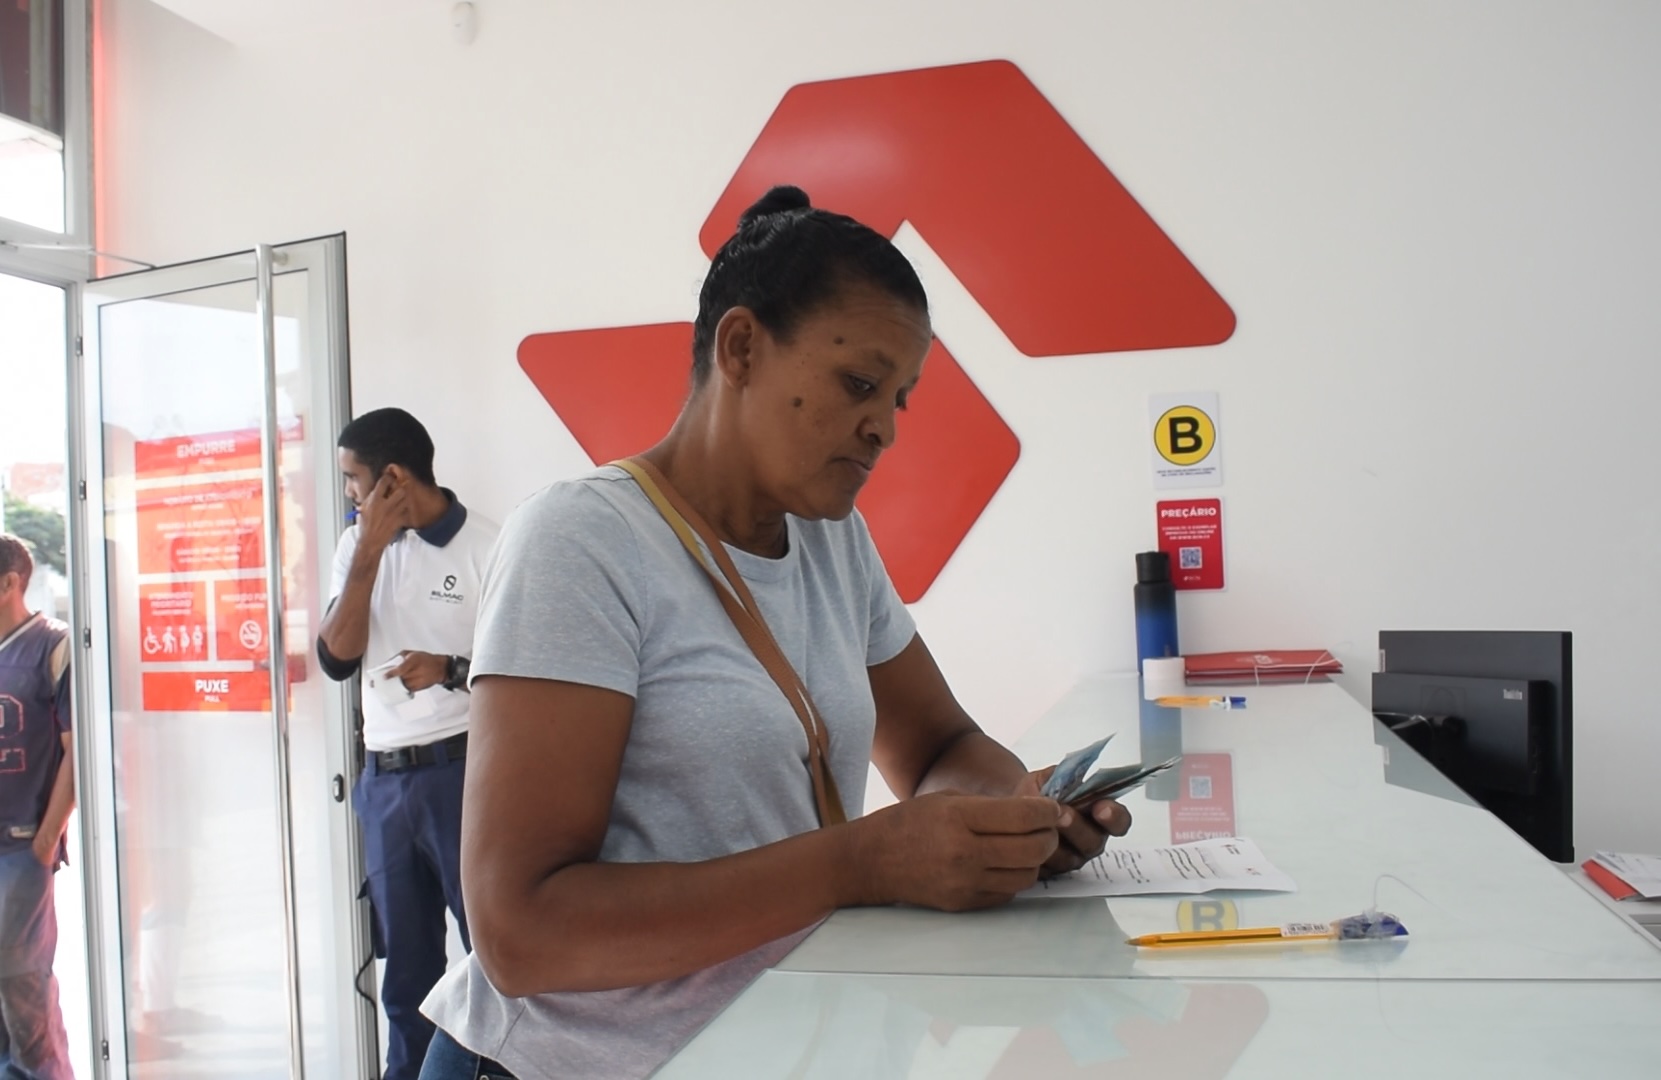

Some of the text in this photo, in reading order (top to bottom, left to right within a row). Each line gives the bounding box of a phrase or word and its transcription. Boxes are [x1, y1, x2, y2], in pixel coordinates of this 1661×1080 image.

[1168, 416, 1203, 455] B
[176, 439, 236, 459] EMPURRE
[1161, 506, 1217, 519] PREÇÁRIO
[195, 679, 230, 694] PUXE
